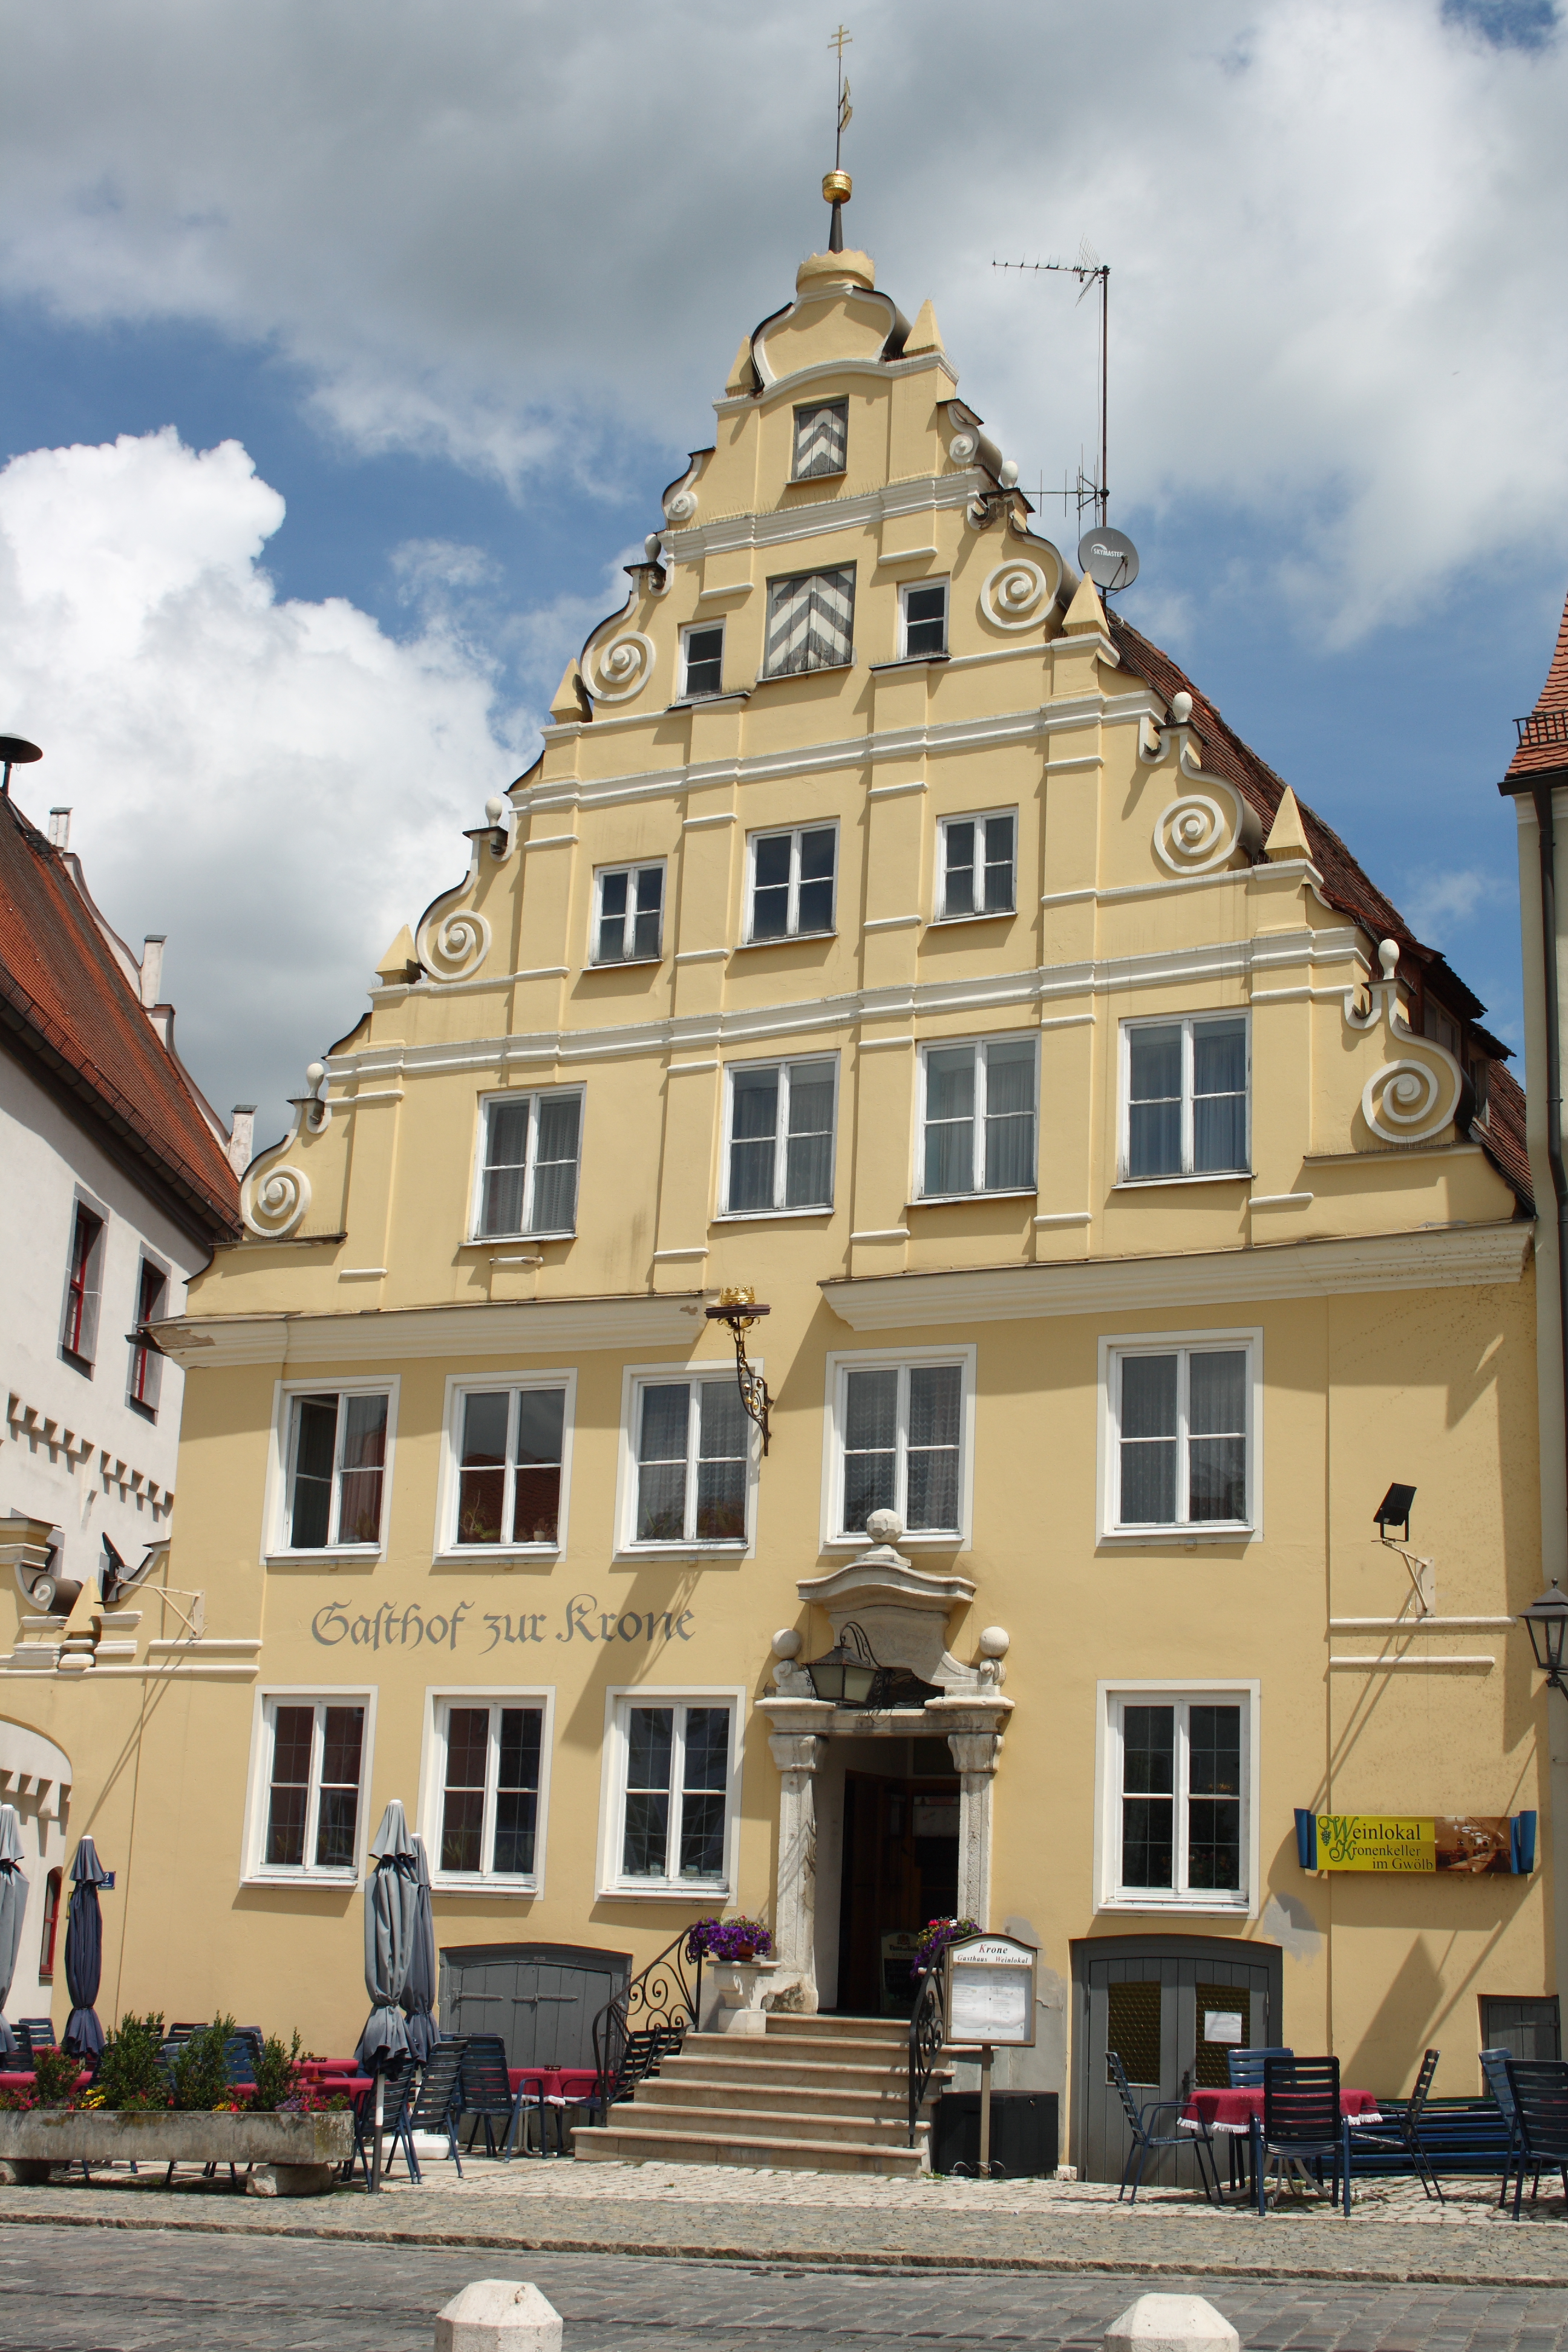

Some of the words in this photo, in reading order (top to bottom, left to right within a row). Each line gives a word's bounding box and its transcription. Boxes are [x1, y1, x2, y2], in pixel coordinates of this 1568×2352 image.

[1093, 548, 1125, 557] SKYMASTER
[478, 1611, 547, 1655] zur
[555, 1593, 696, 1643] Krone
[1318, 1816, 1421, 1841] Weinlokal
[1329, 1840, 1421, 1862] Kronenkeller
[1373, 1857, 1388, 1869] im
[1392, 1857, 1433, 1870] Gwölb
[979, 1944, 1008, 1954] Krone
